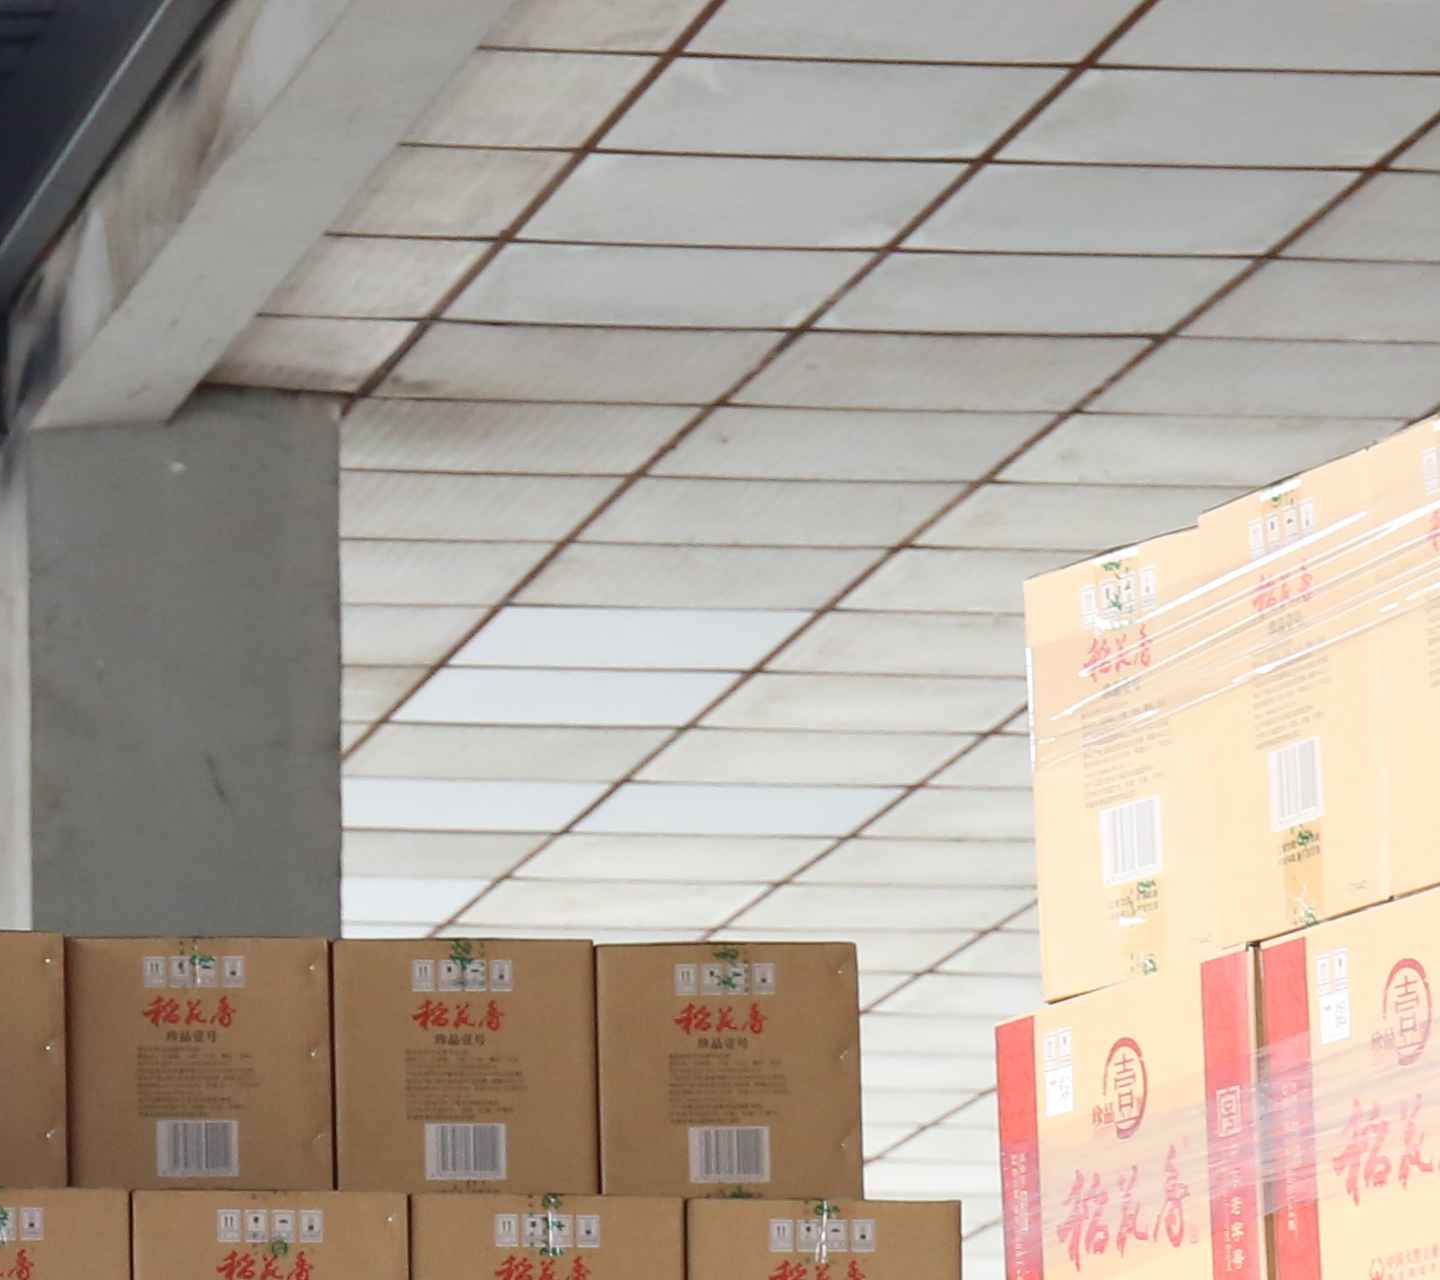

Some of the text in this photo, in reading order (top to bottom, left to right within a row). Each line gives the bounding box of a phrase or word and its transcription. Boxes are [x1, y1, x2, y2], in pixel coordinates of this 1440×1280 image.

[144, 995, 236, 1029] 稻花香
[673, 1002, 766, 1035] 稻花香
[1054, 1142, 1192, 1274] 稻花香
